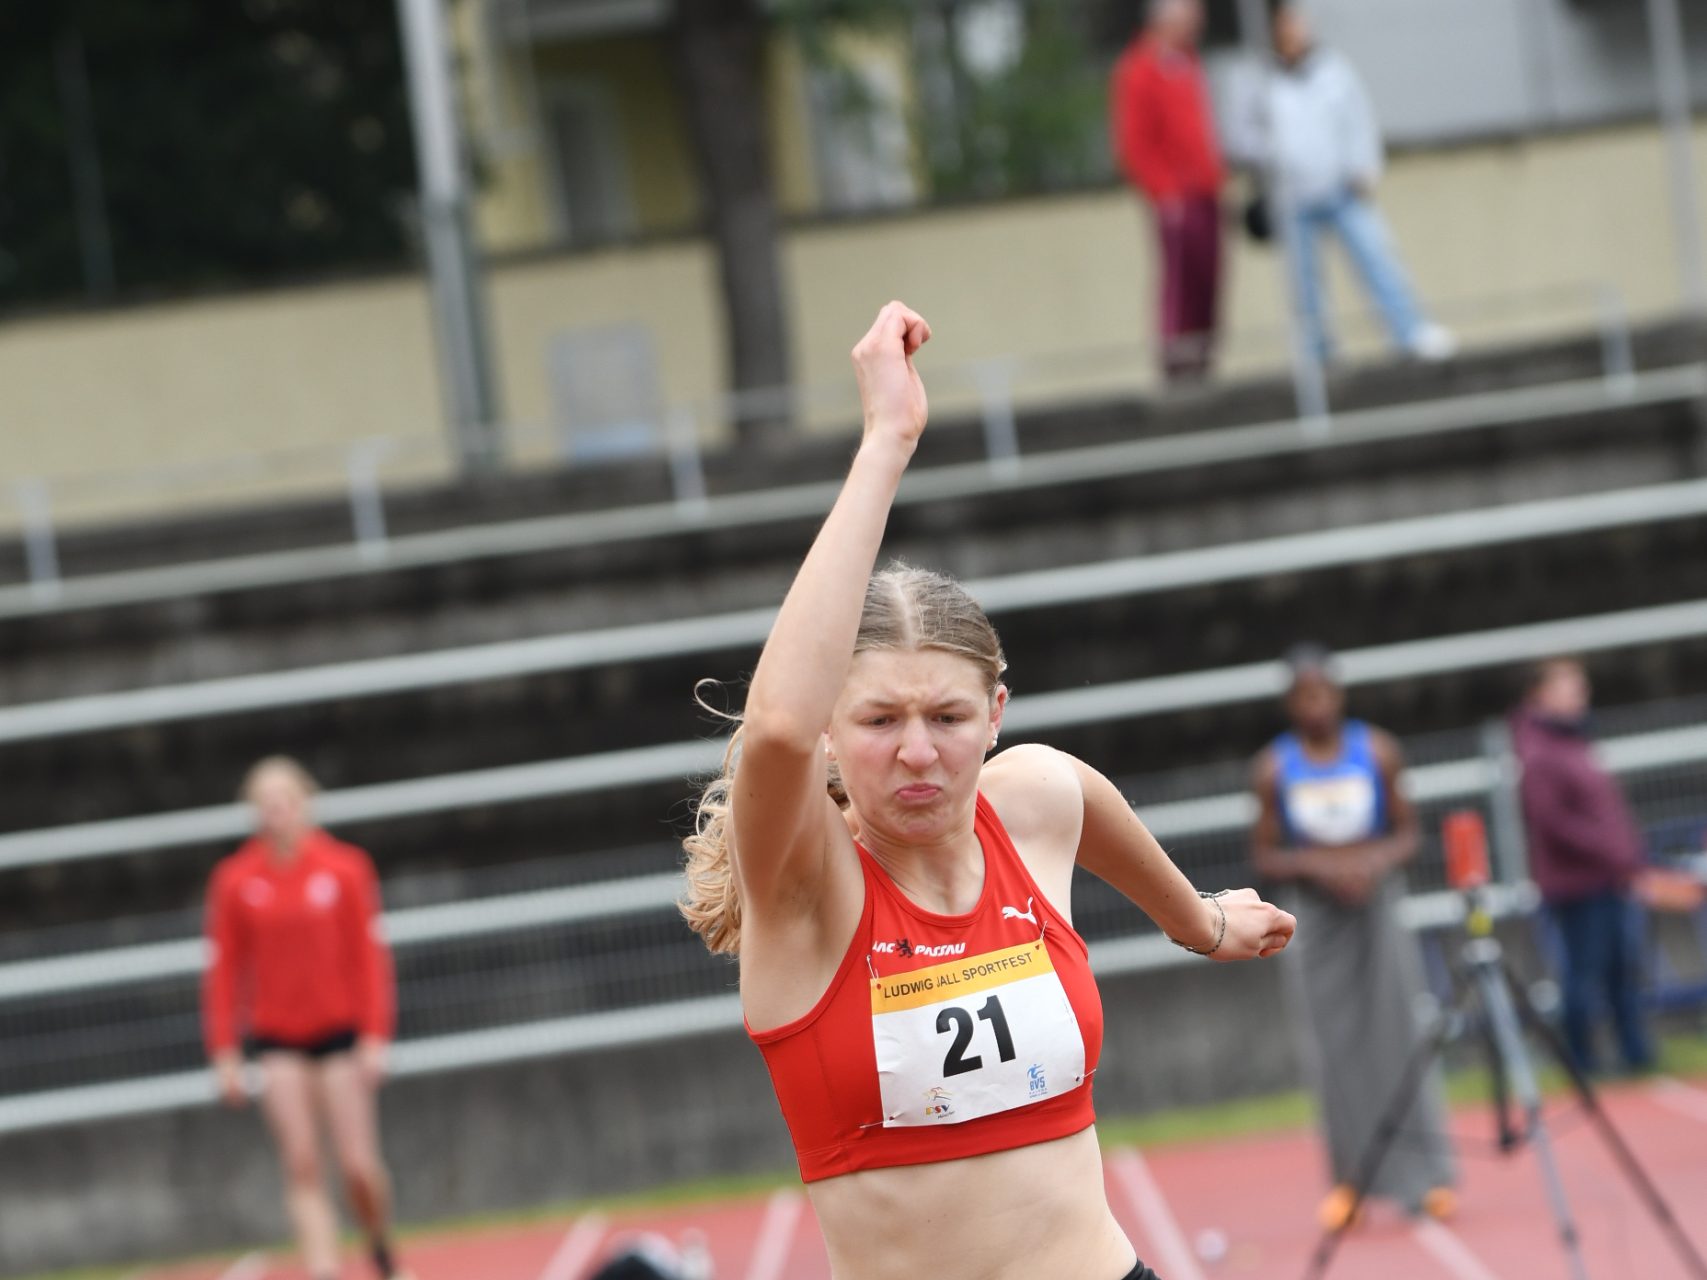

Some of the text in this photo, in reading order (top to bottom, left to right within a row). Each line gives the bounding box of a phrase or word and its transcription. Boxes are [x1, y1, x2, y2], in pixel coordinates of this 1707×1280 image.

[914, 942, 967, 957] PASSAU
[884, 952, 1033, 999] LUDWIG JALL SPORTFEST
[935, 994, 1017, 1078] 21
